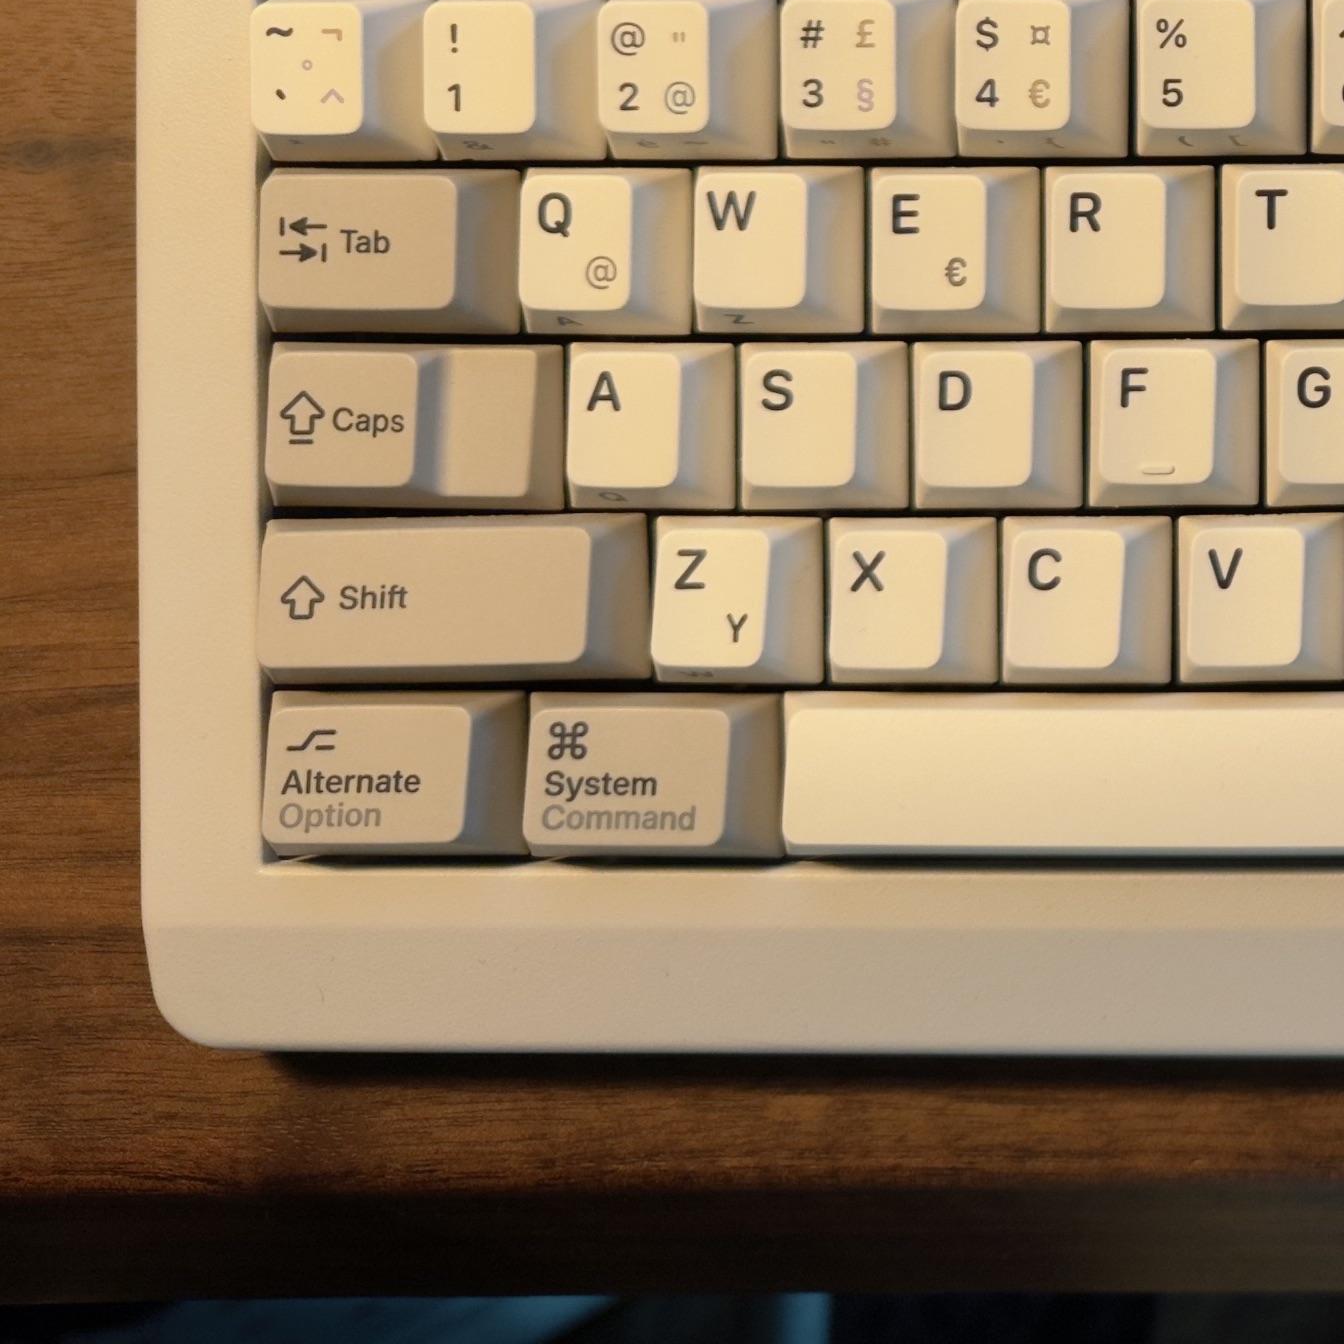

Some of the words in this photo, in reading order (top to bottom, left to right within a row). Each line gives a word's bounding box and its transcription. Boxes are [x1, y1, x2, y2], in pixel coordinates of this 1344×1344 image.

[450, 24, 458, 53] !
[610, 22, 645, 56] @
[800, 20, 824, 48] #
[976, 17, 999, 51] $
[1156, 18, 1187, 49] %
[619, 82, 639, 111] 2
[664, 81, 696, 115] @
[802, 79, 823, 108] 3
[975, 79, 999, 107] 4
[1028, 79, 1050, 109] €
[1162, 79, 1183, 107] 5
[538, 193, 572, 237] Q
[706, 191, 756, 231] W
[892, 194, 919, 234] E
[1069, 192, 1101, 233] R
[1255, 189, 1288, 230] T
[340, 229, 390, 254] Tab
[585, 256, 617, 290] @
[945, 257, 967, 287] €
[587, 371, 621, 412] A
[761, 369, 793, 411] S
[938, 371, 972, 411] D
[1120, 368, 1148, 408] F
[1297, 367, 1331, 409] G
[332, 407, 404, 438] Caps
[674, 549, 707, 590] Z
[850, 551, 885, 592] X
[1028, 548, 1062, 591] C
[1208, 548, 1242, 590] V
[339, 584, 408, 610] Shift
[727, 614, 748, 643] Y
[281, 769, 421, 795] Alternate
[545, 770, 657, 802] System
[279, 802, 381, 834] Option
[541, 804, 696, 832] Command
